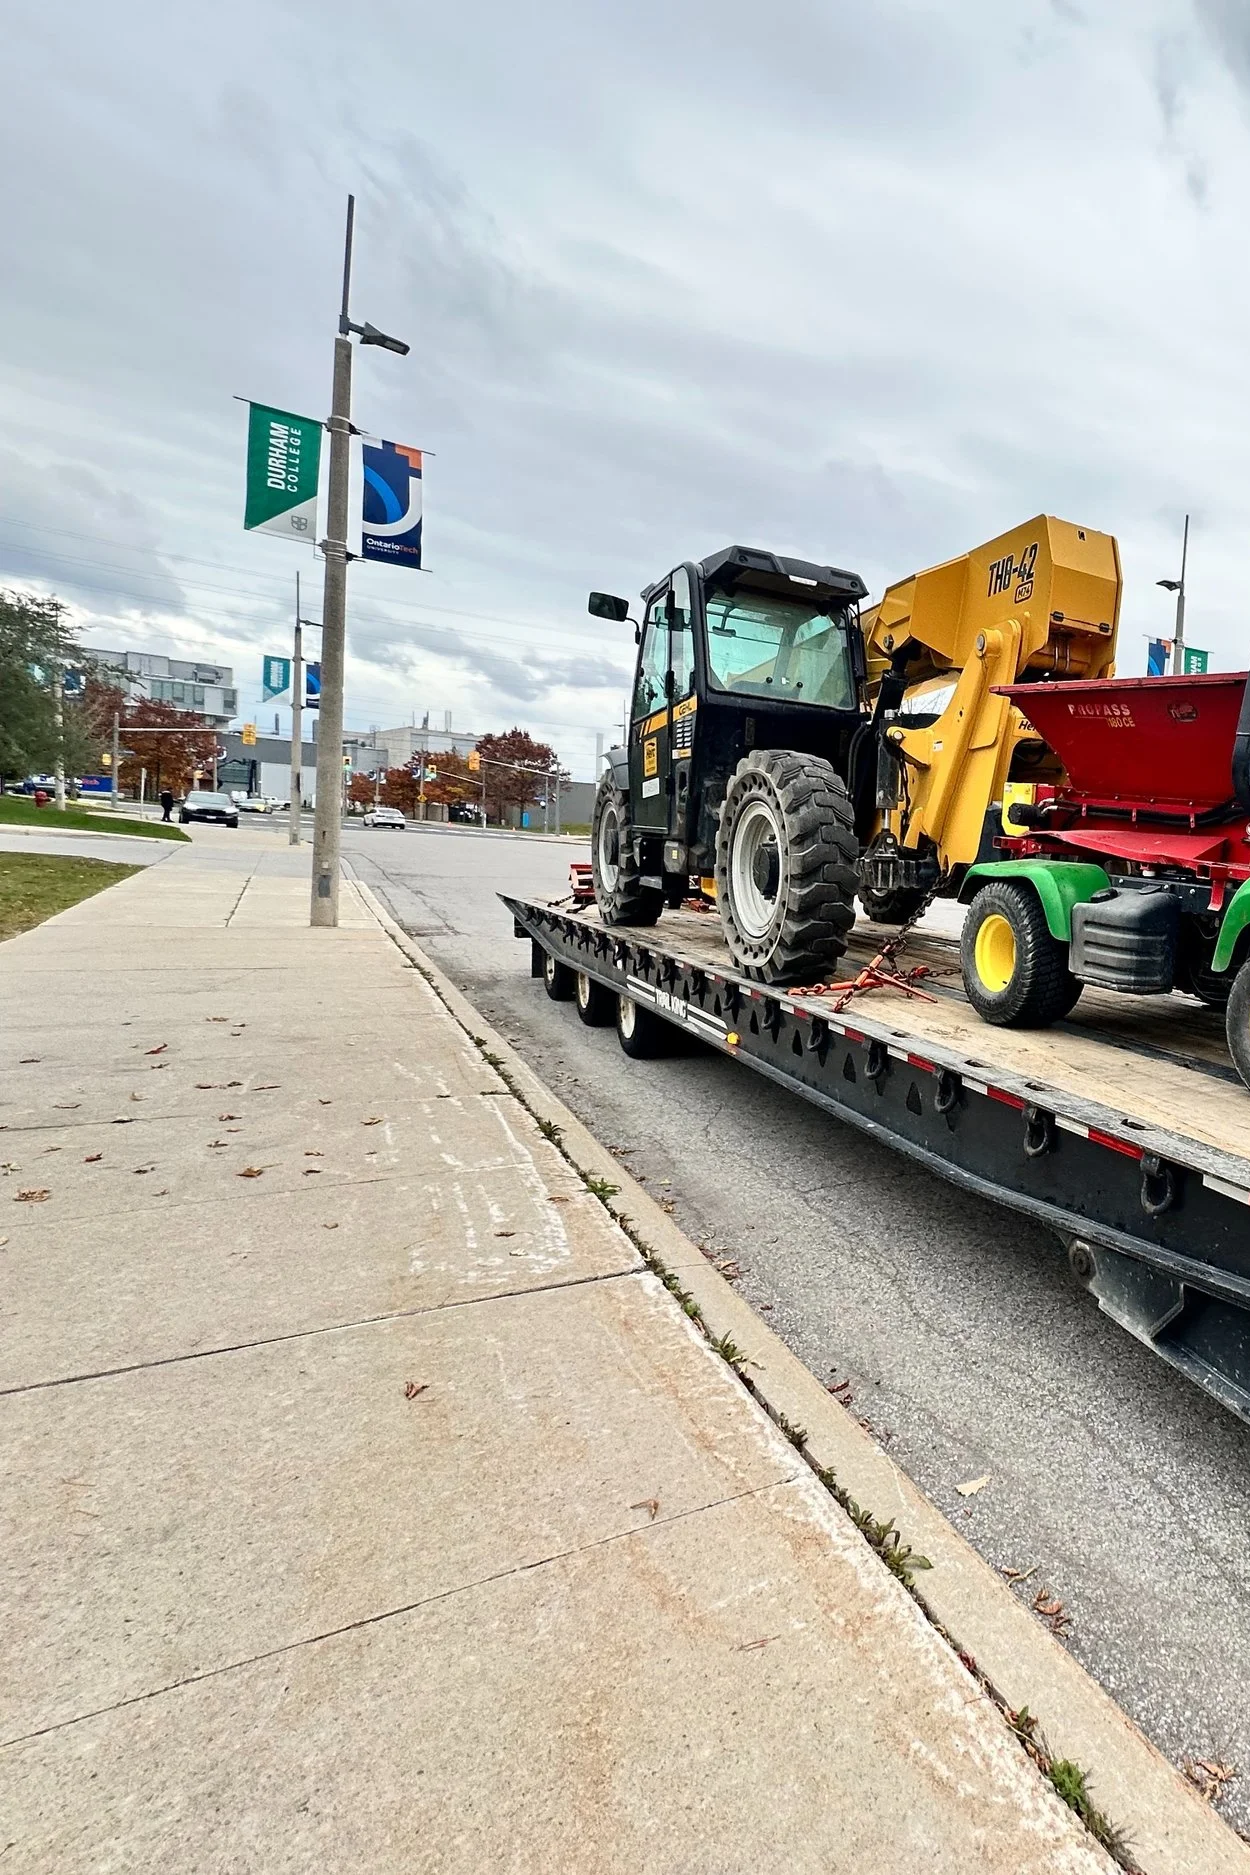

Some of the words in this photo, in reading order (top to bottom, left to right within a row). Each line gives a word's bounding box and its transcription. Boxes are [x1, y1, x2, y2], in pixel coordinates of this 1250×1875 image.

[267, 421, 290, 490] DURHAM
[286, 427, 302, 493] COLLEGE
[1018, 720, 1035, 731] He
[1067, 703, 1131, 716] PROPASS
